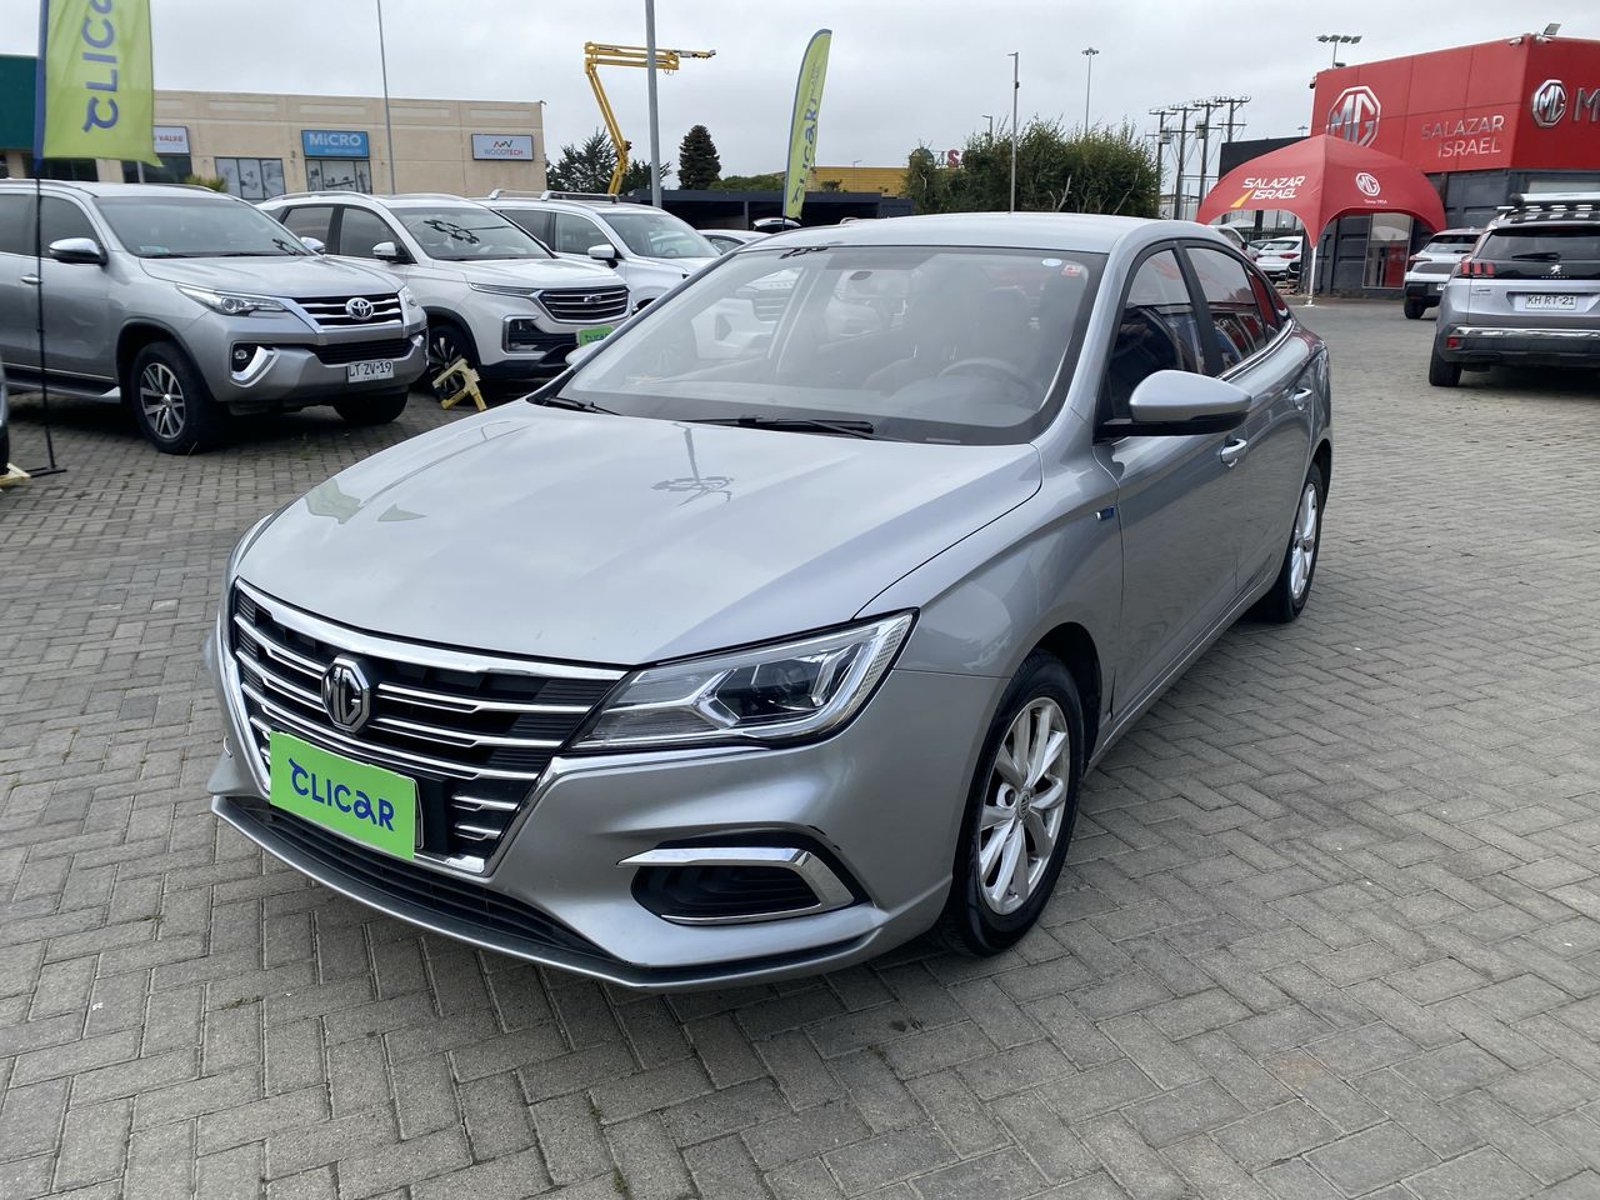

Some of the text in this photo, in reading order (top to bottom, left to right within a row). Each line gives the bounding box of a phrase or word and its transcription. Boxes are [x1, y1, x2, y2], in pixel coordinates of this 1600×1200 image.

[1421, 115, 1505, 140] SALAZAR
[1438, 137, 1501, 158] ISRAEL
[1243, 175, 1306, 188] SALAZAR
[1252, 188, 1297, 200] ISRAEL
[323, 666, 362, 725] MG
